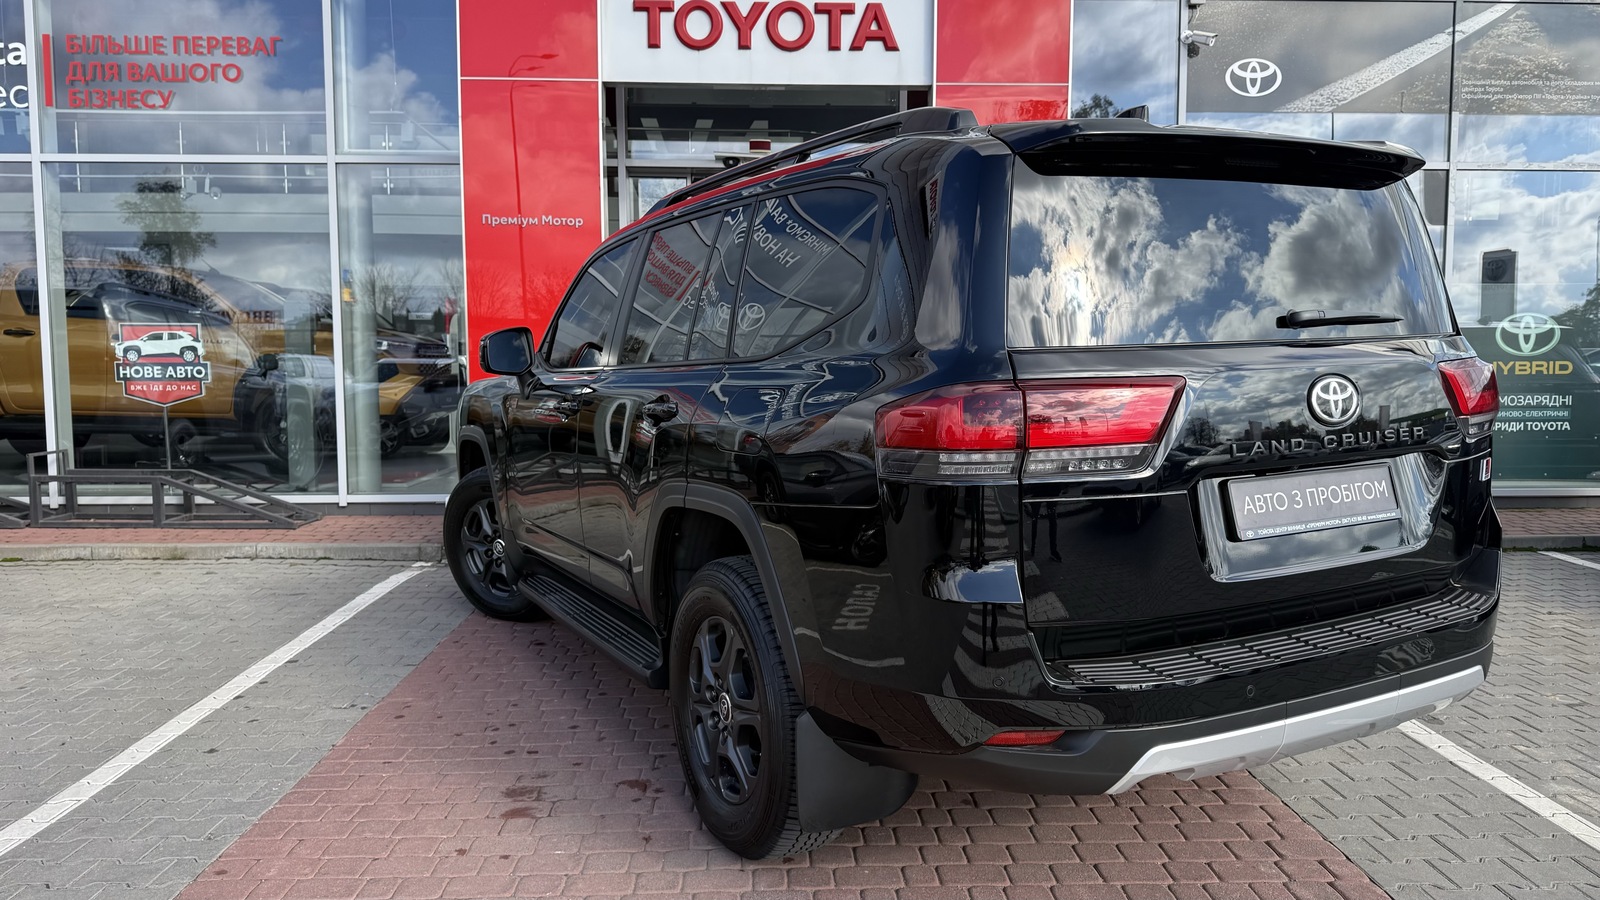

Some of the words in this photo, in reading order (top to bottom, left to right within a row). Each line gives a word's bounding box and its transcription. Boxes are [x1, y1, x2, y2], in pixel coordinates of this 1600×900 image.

[633, 0, 900, 52] TOYOTA
[65, 34, 164, 55] БІЛЬШЕ
[172, 35, 283, 56] ПЕРЕВАГ
[65, 61, 119, 84] ДЛЯ
[126, 62, 242, 83] ВАШОГО
[68, 89, 174, 109] БІЗНЕСУ
[481, 213, 539, 228] Преміум
[541, 214, 584, 228] Мотор
[119, 366, 162, 378] НОВЕ
[165, 366, 206, 378] АВТО
[150, 383, 163, 391] ЇДЕ
[1497, 410, 1569, 418] ИНОВО-ЕЛЕКТРИЧНІ
[1493, 421, 1524, 432] РИДИ
[1525, 421, 1571, 431] TOYOTA
[1231, 437, 1305, 457] LAND
[1321, 426, 1425, 449] CRUISER
[1243, 491, 1288, 515] АВТО
[1291, 489, 1303, 509] З
[1305, 479, 1389, 507] ПРОБІГОМ
